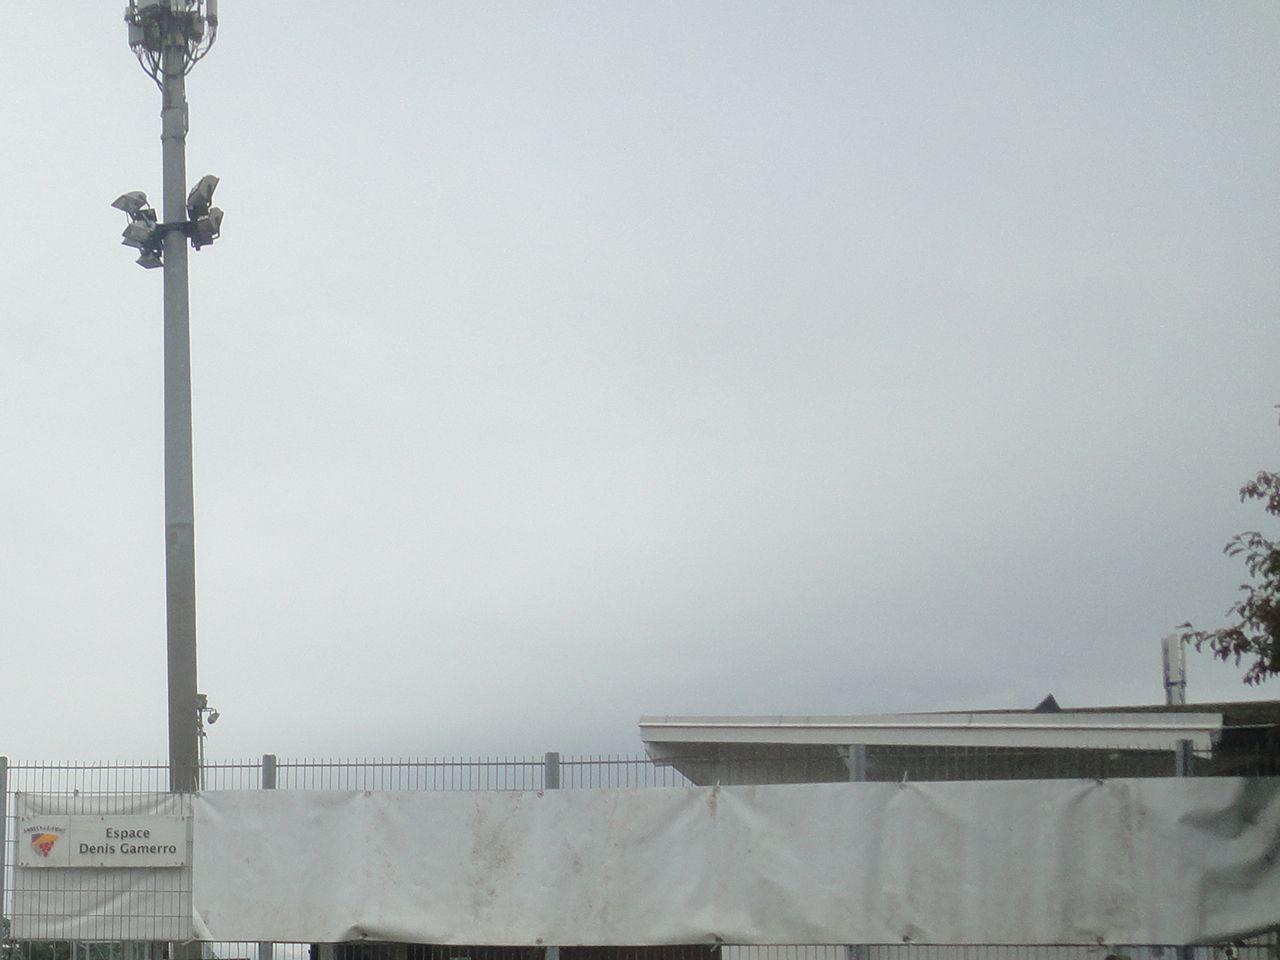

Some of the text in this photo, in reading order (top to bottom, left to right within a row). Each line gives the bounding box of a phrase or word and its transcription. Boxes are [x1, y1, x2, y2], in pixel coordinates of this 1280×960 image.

[106, 828, 150, 840] Espace
[79, 843, 177, 854] Denis Gamerro
